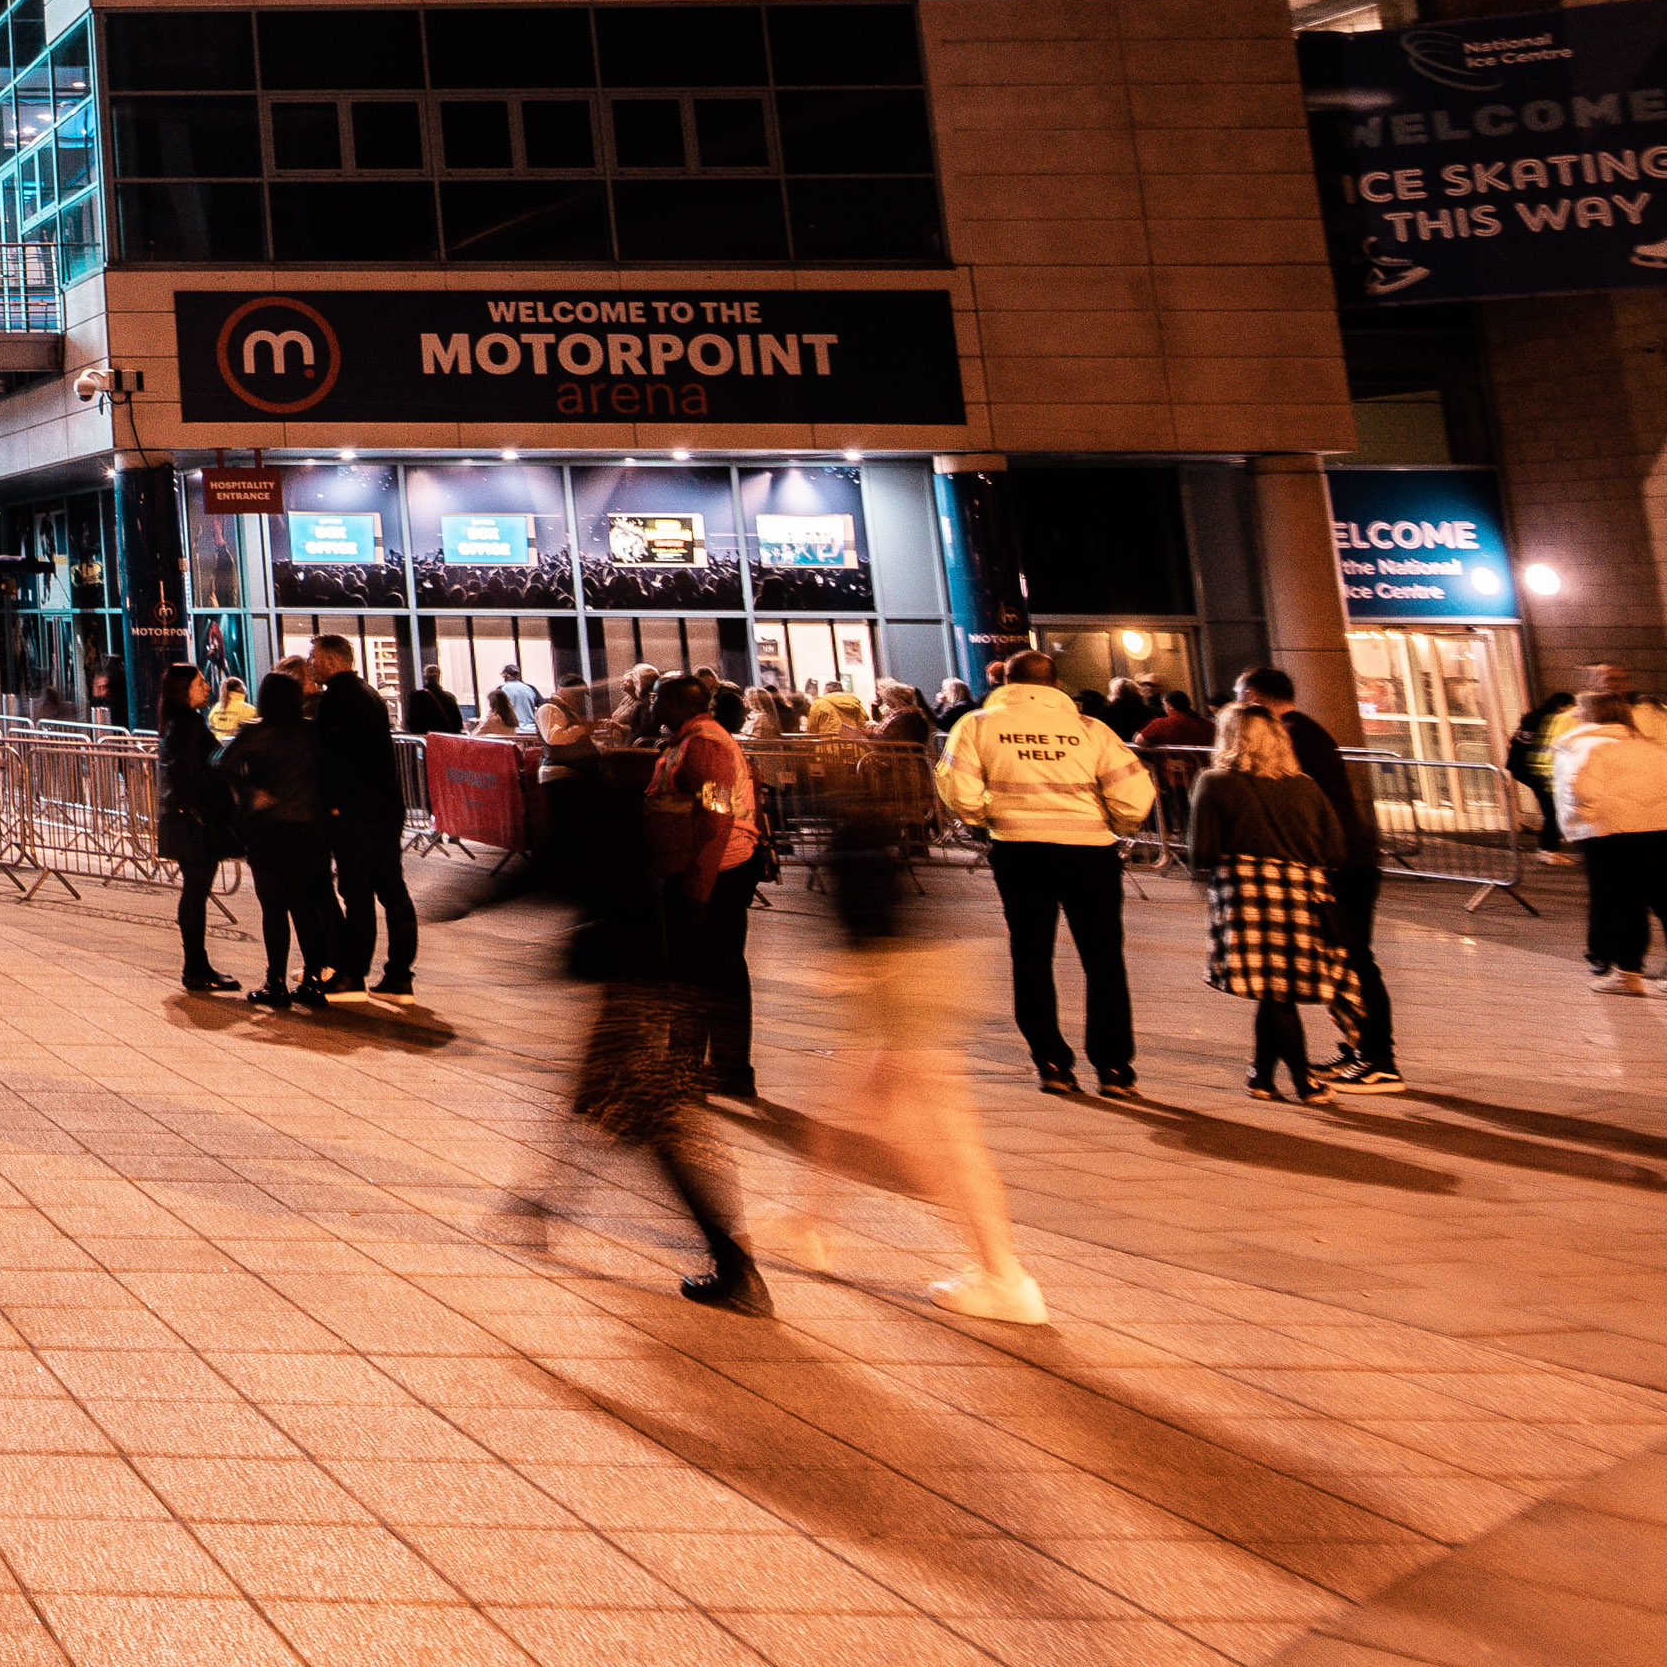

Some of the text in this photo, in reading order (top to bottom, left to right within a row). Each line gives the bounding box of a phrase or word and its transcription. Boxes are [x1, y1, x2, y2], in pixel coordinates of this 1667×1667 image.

[1464, 33, 1553, 53] National
[1466, 47, 1574, 68] Ice Centre
[1343, 145, 1667, 204] ICE SKATING
[1383, 191, 1652, 242] THIS WAY
[487, 301, 762, 324] WELCOME TO THE
[420, 333, 839, 376] MOTORPOINT
[556, 381, 708, 415] arena
[210, 481, 275, 491] HOSPITALITY
[216, 492, 271, 501] ENTRANCE
[1331, 520, 1480, 549] ELCOME
[1342, 558, 1463, 575] the National
[1375, 582, 1445, 599] Centre
[999, 734, 1080, 746] HERE TO
[1018, 750, 1066, 761] HELP
